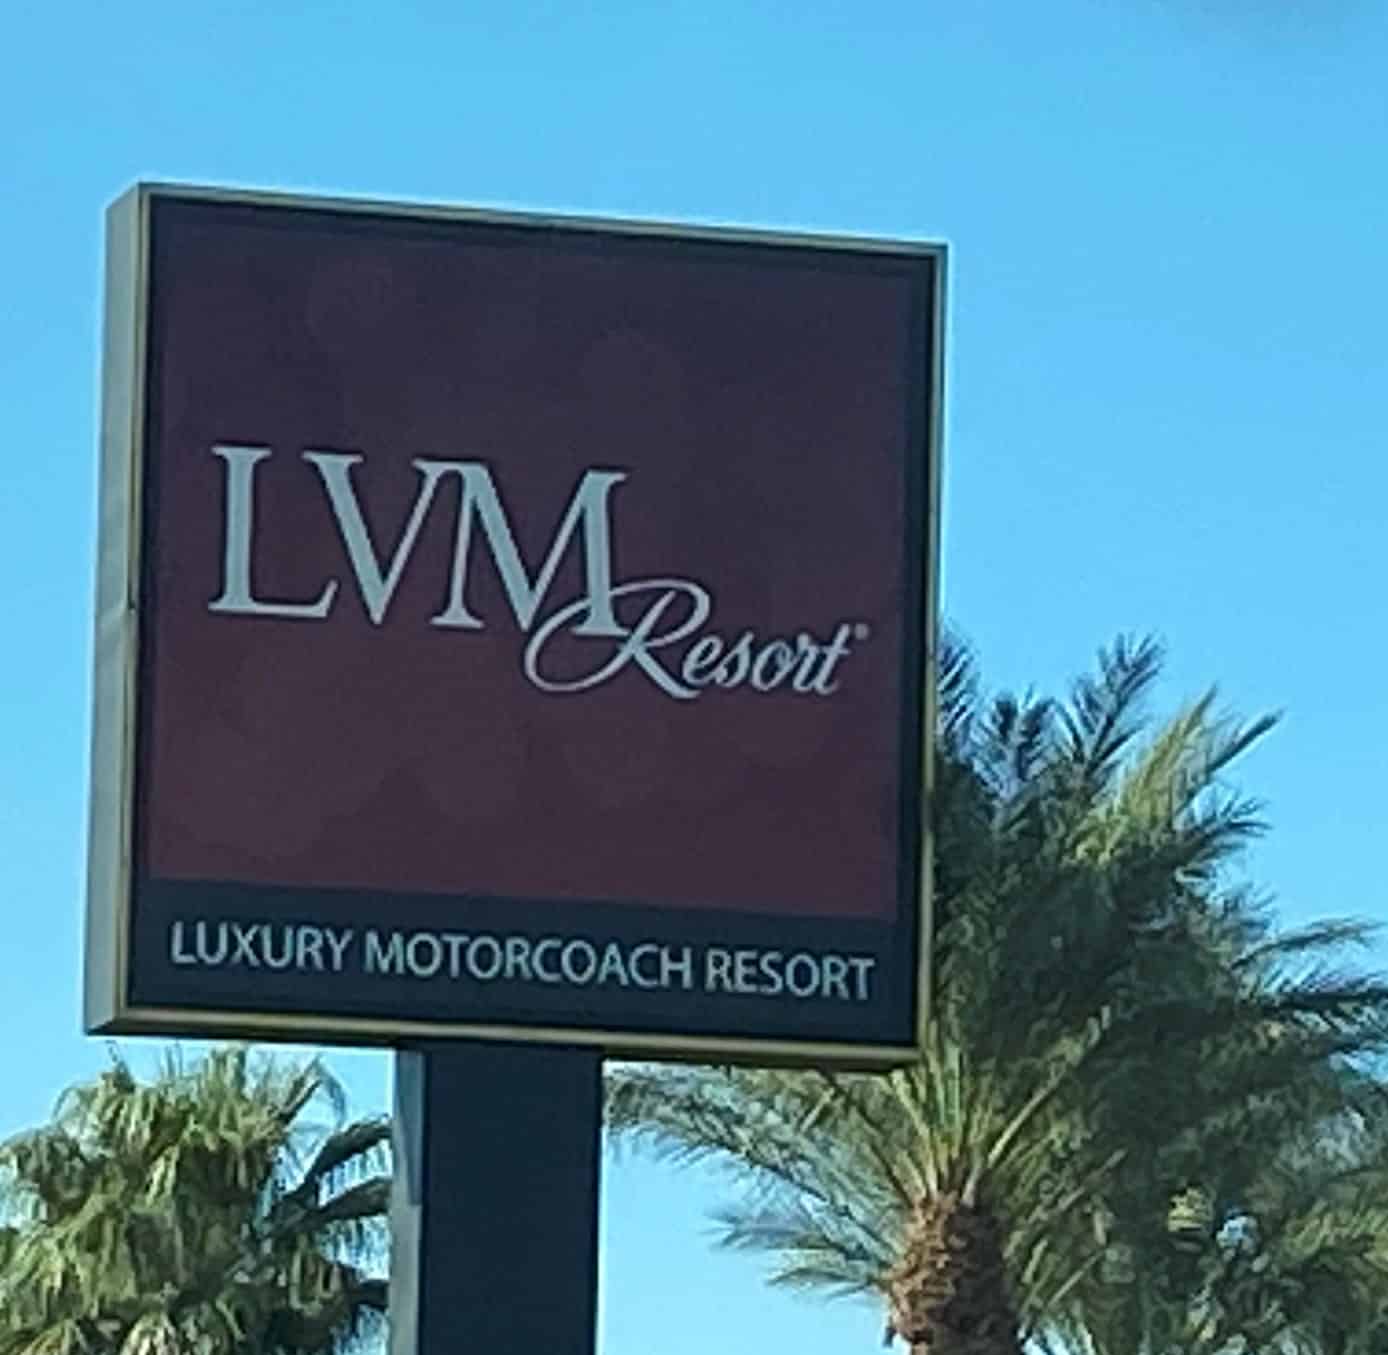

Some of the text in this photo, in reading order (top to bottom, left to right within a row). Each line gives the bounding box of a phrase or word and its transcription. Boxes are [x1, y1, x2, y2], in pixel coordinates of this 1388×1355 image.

[206, 444, 629, 637] LVM
[524, 578, 856, 700] Resort
[169, 921, 876, 1001] LUXURY MOTORCOACH RESORT
